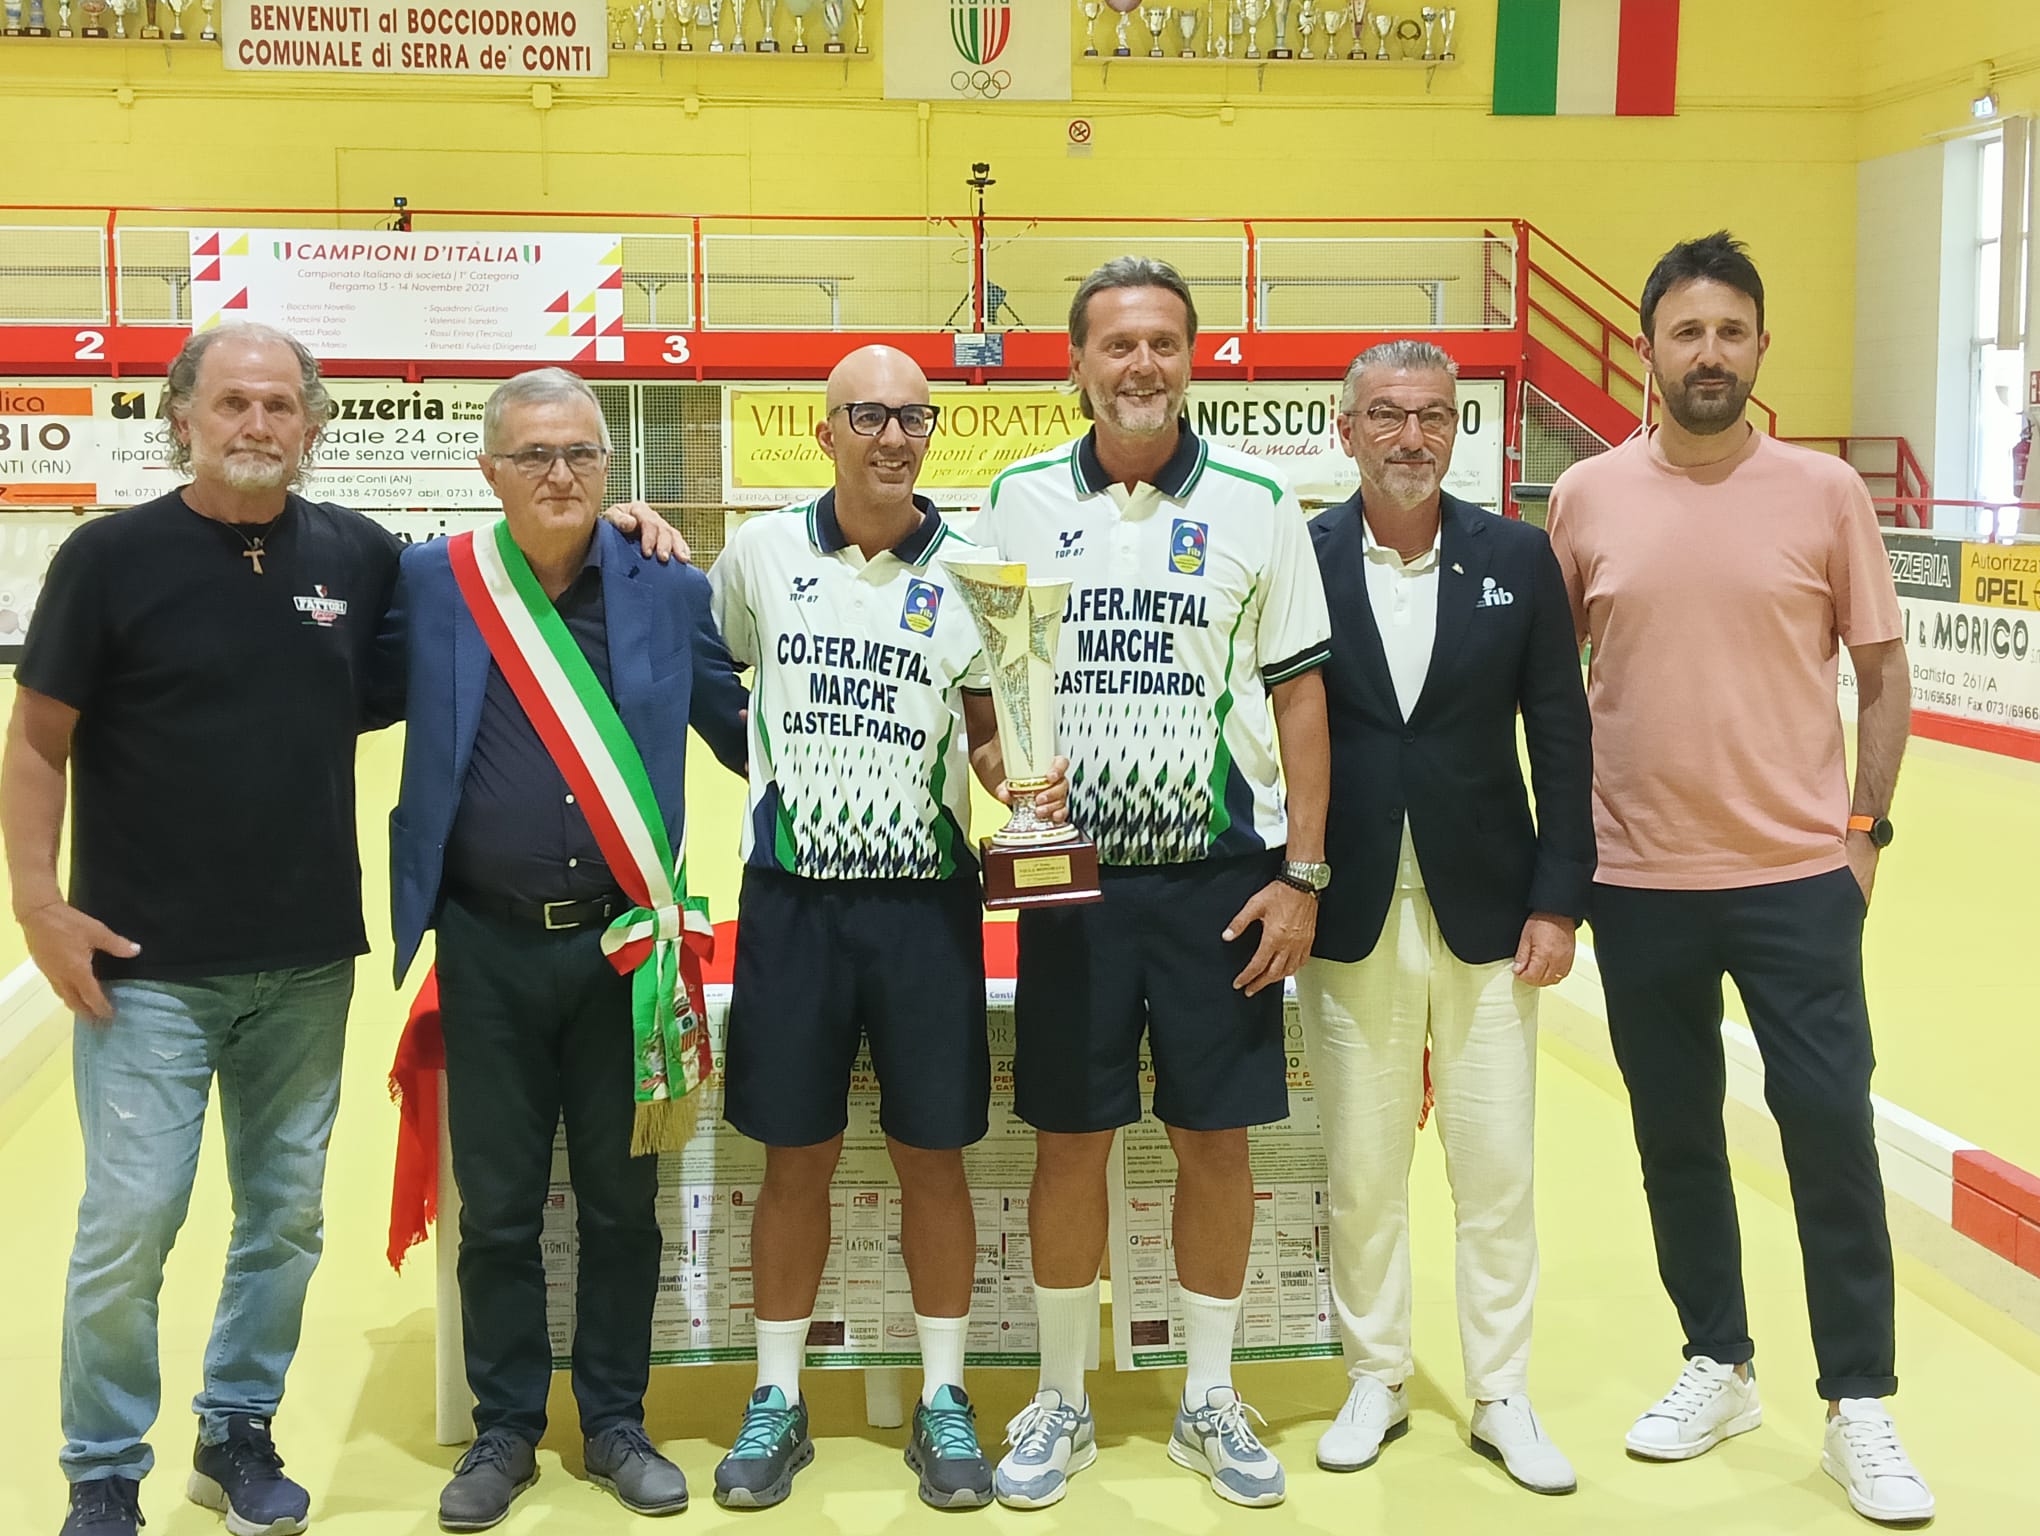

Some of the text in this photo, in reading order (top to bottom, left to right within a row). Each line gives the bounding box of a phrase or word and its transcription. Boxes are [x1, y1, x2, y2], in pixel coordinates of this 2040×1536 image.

[250, 4, 576, 37] BENVENUTI al BOCCIODROMO
[239, 39, 362, 67] COMUNALE
[372, 42, 391, 68] di
[402, 43, 469, 69] SERRA
[522, 45, 591, 71] CONTI
[298, 243, 416, 262] CAMPIONI
[297, 269, 361, 280] Campionato
[363, 269, 401, 279] Italiano
[404, 271, 413, 280] di
[469, 271, 520, 282] Categoria
[329, 282, 376, 293] Bergamo
[378, 282, 388, 291] 13
[399, 283, 408, 291] 14
[411, 283, 463, 292] Novembre
[465, 283, 490, 292] 2021
[74, 330, 105, 360] 2
[662, 335, 690, 364] 3
[1214, 336, 1242, 365] 4
[452, 401, 462, 410] di
[452, 412, 483, 421] Bruno
[395, 428, 426, 444] 24
[436, 431, 480, 444] ore
[356, 450, 405, 461] senza
[1265, 438, 1323, 456] moda
[32, 459, 72, 475] (AN)
[356, 474, 387, 484] Conti
[1971, 552, 2040, 574] Autorizza
[1975, 576, 2030, 606] OPEL
[1932, 611, 2029, 661] MORICO
[1078, 629, 1174, 664] MARCHE
[1912, 664, 1998, 693] Battista 261/A
[809, 672, 898, 714] MARCHE
[1967, 696, 1983, 713] Fax
